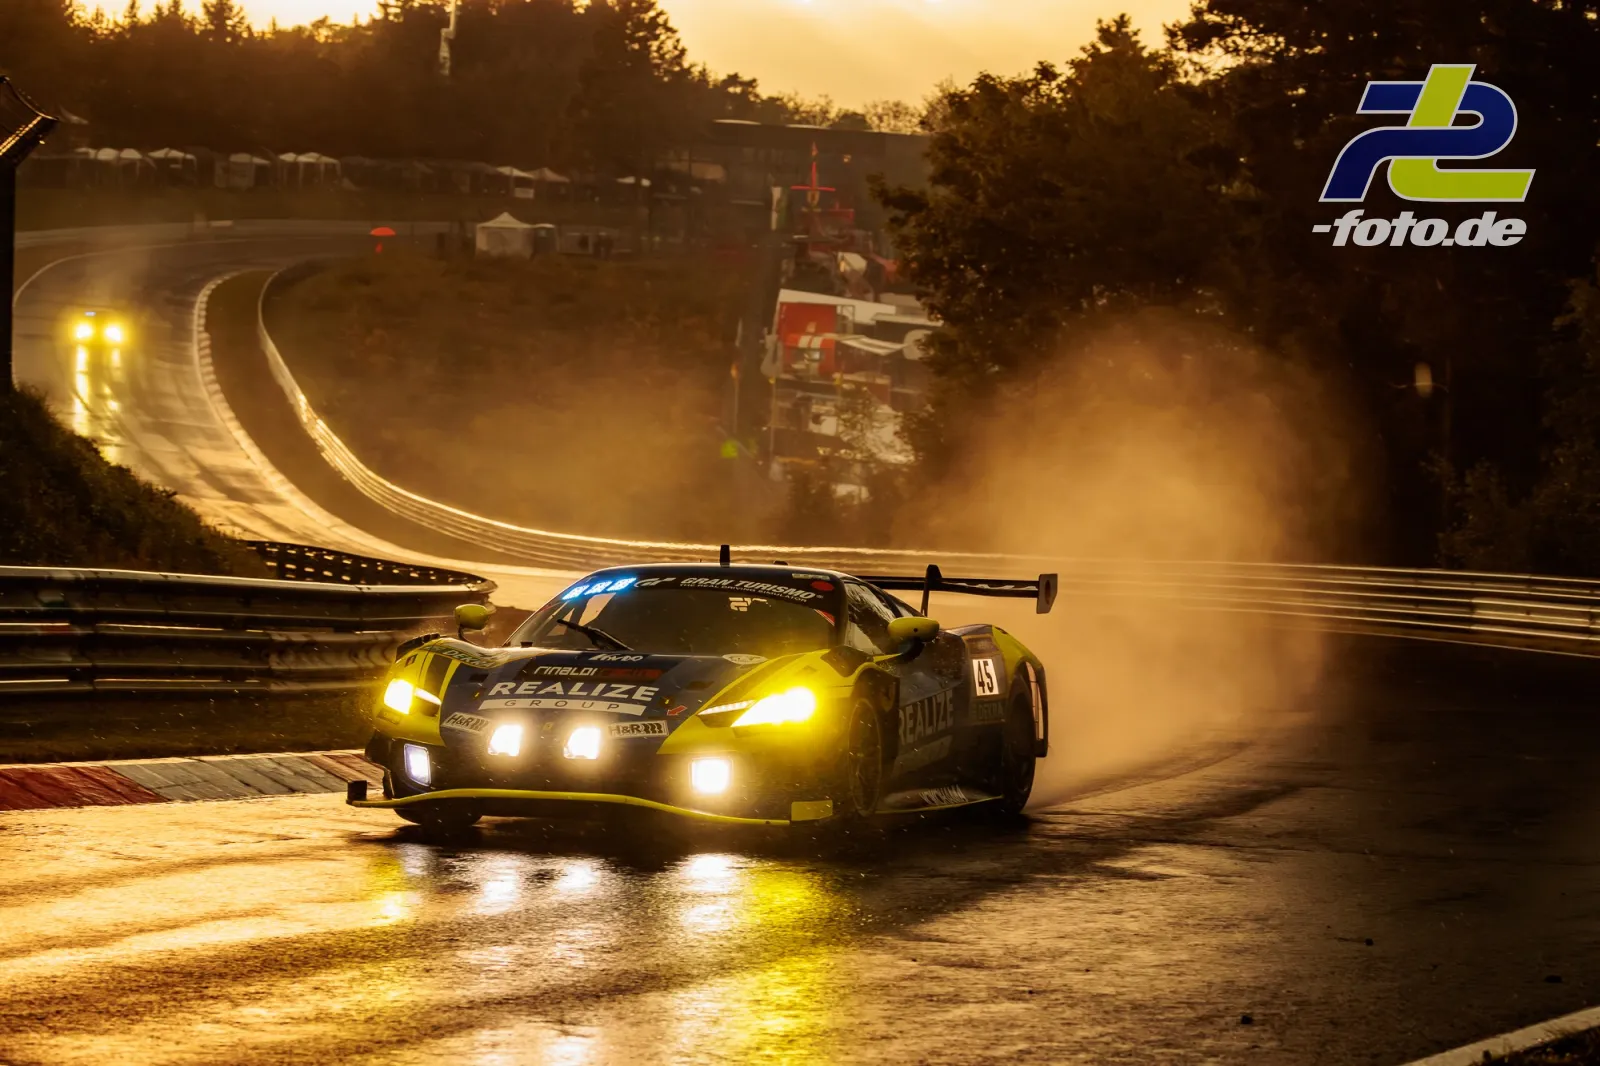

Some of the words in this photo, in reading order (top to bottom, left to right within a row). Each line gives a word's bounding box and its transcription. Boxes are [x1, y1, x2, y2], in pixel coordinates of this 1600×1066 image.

[680, 577, 735, 587] GRAN
[735, 580, 816, 599] TURISMO
[757, 589, 807, 602] SIMULATOR
[977, 660, 995, 694] 45
[488, 681, 660, 702] REALIZE
[504, 699, 620, 711] GROUP
[899, 689, 954, 747] REALIZE
